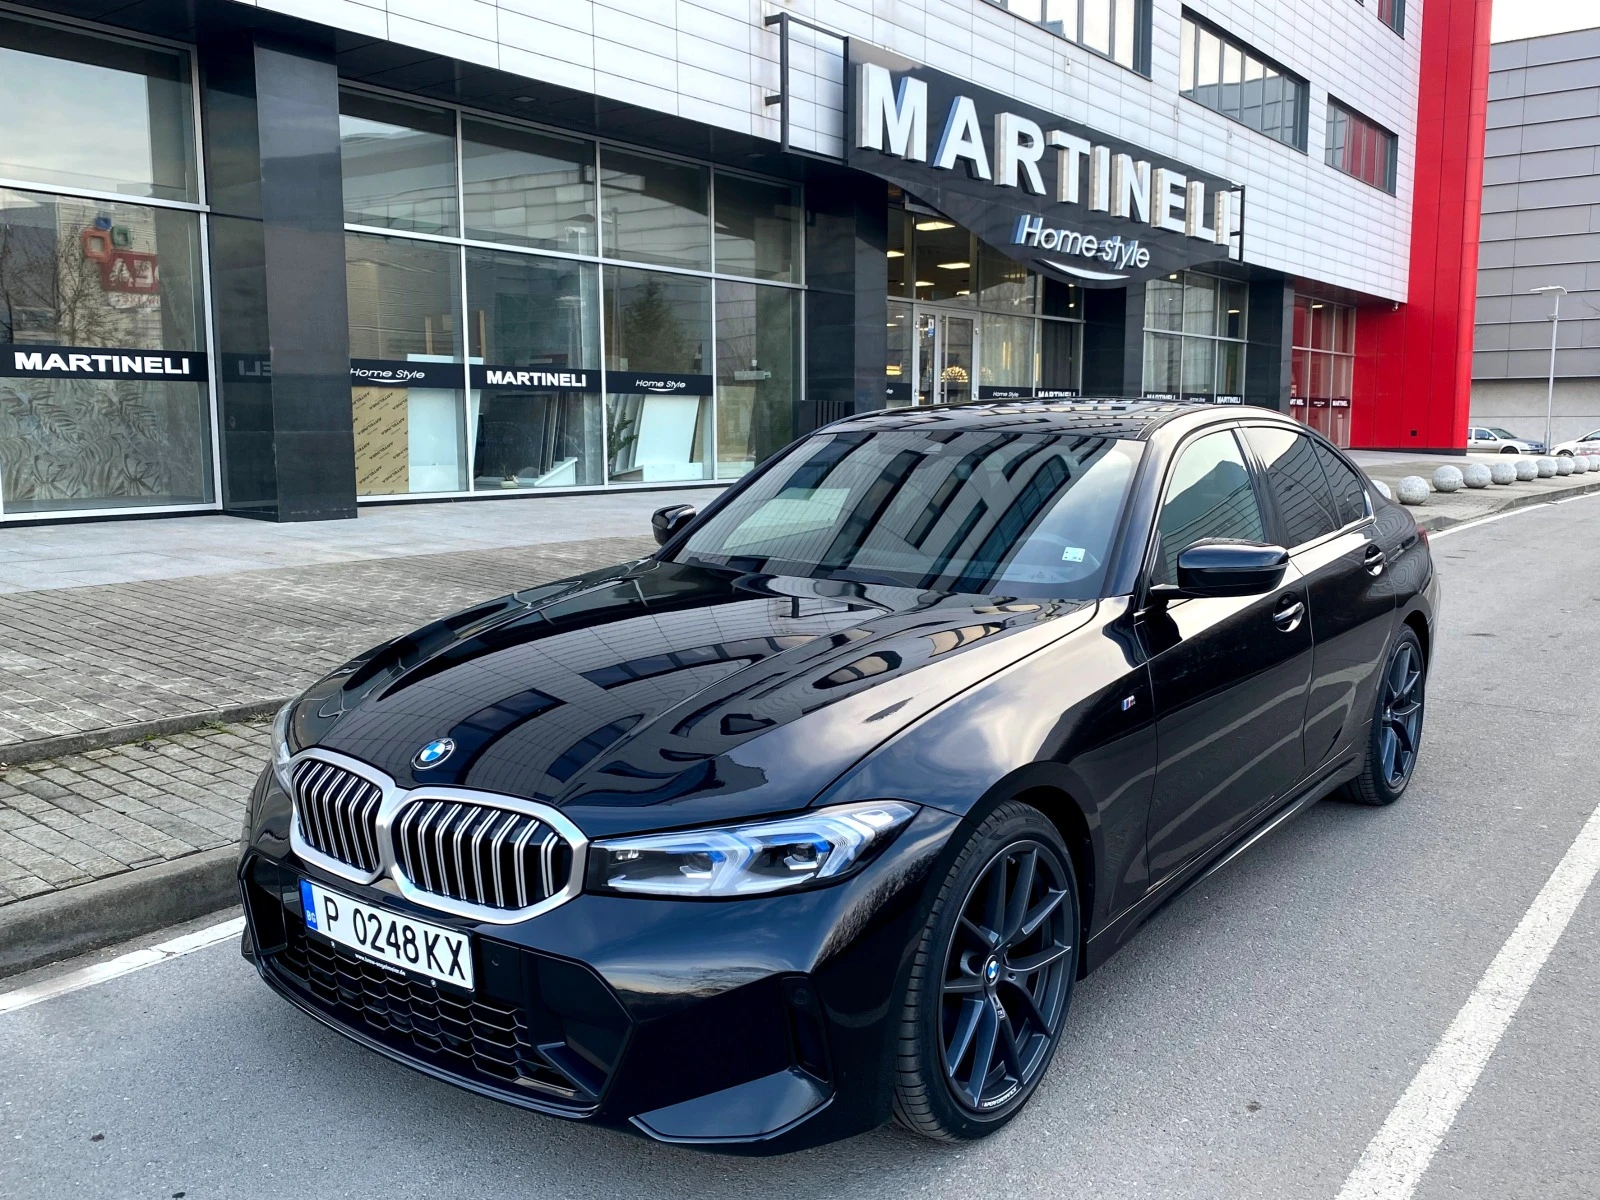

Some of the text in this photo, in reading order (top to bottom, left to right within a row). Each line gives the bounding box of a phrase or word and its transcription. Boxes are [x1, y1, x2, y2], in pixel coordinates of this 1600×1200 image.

[856, 62, 1232, 246] MARTINELI
[1015, 214, 1150, 270] Home style
[14, 352, 190, 374] MARTINELI
[350, 368, 425, 380] Home Style
[486, 370, 587, 387] MARTINELI
[635, 379, 686, 389] Home Style
[1217, 396, 1241, 404] MARTINELI
[306, 910, 317, 923] BG
[323, 895, 339, 932] P
[353, 908, 420, 964] 0248
[424, 929, 467, 981] KX
